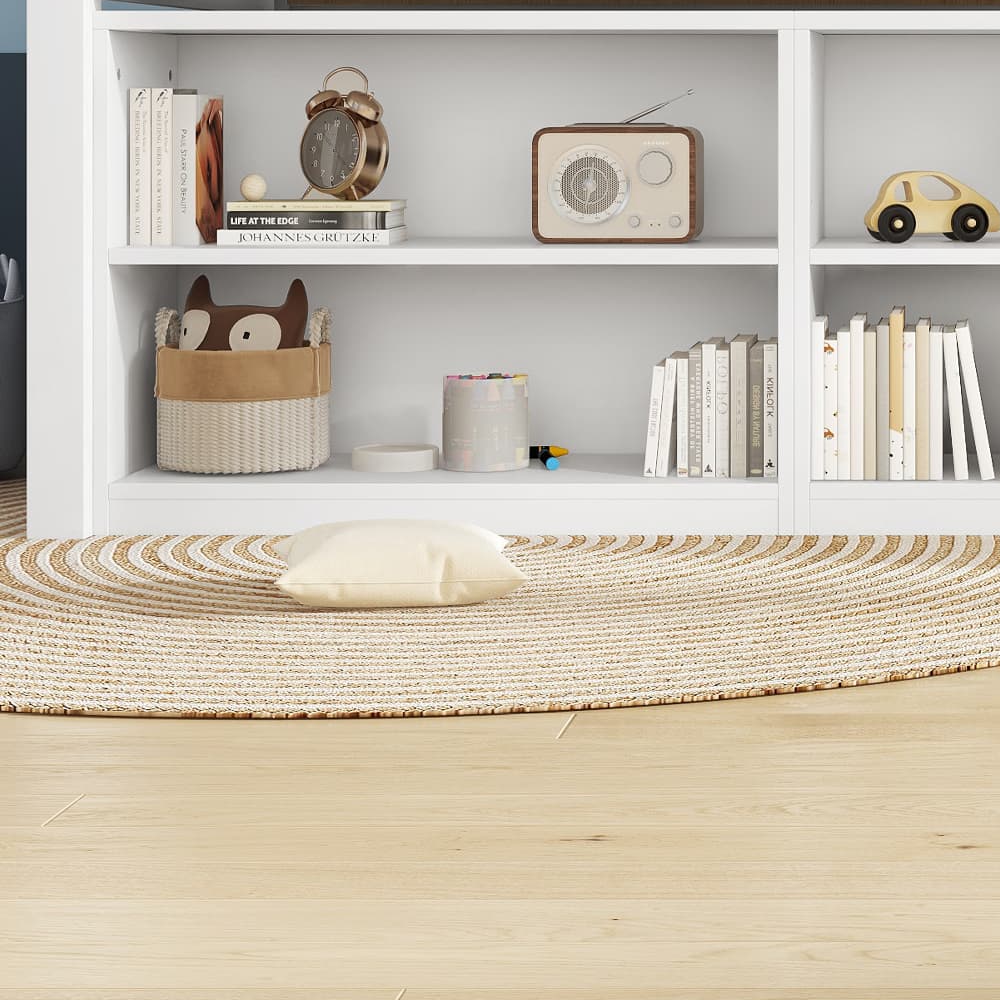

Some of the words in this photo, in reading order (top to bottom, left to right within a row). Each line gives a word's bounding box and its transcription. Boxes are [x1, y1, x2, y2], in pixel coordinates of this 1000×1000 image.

[334, 119, 341, 128] 12
[180, 128, 189, 148] PAUL
[180, 173, 189, 185] ON
[180, 187, 189, 215] BEAUTY
[230, 217, 247, 225] LIFE
[247, 217, 258, 225] AT
[259, 217, 276, 225] THE
[277, 217, 299, 225] EDGE
[237, 232, 311, 243] JOHANNES
